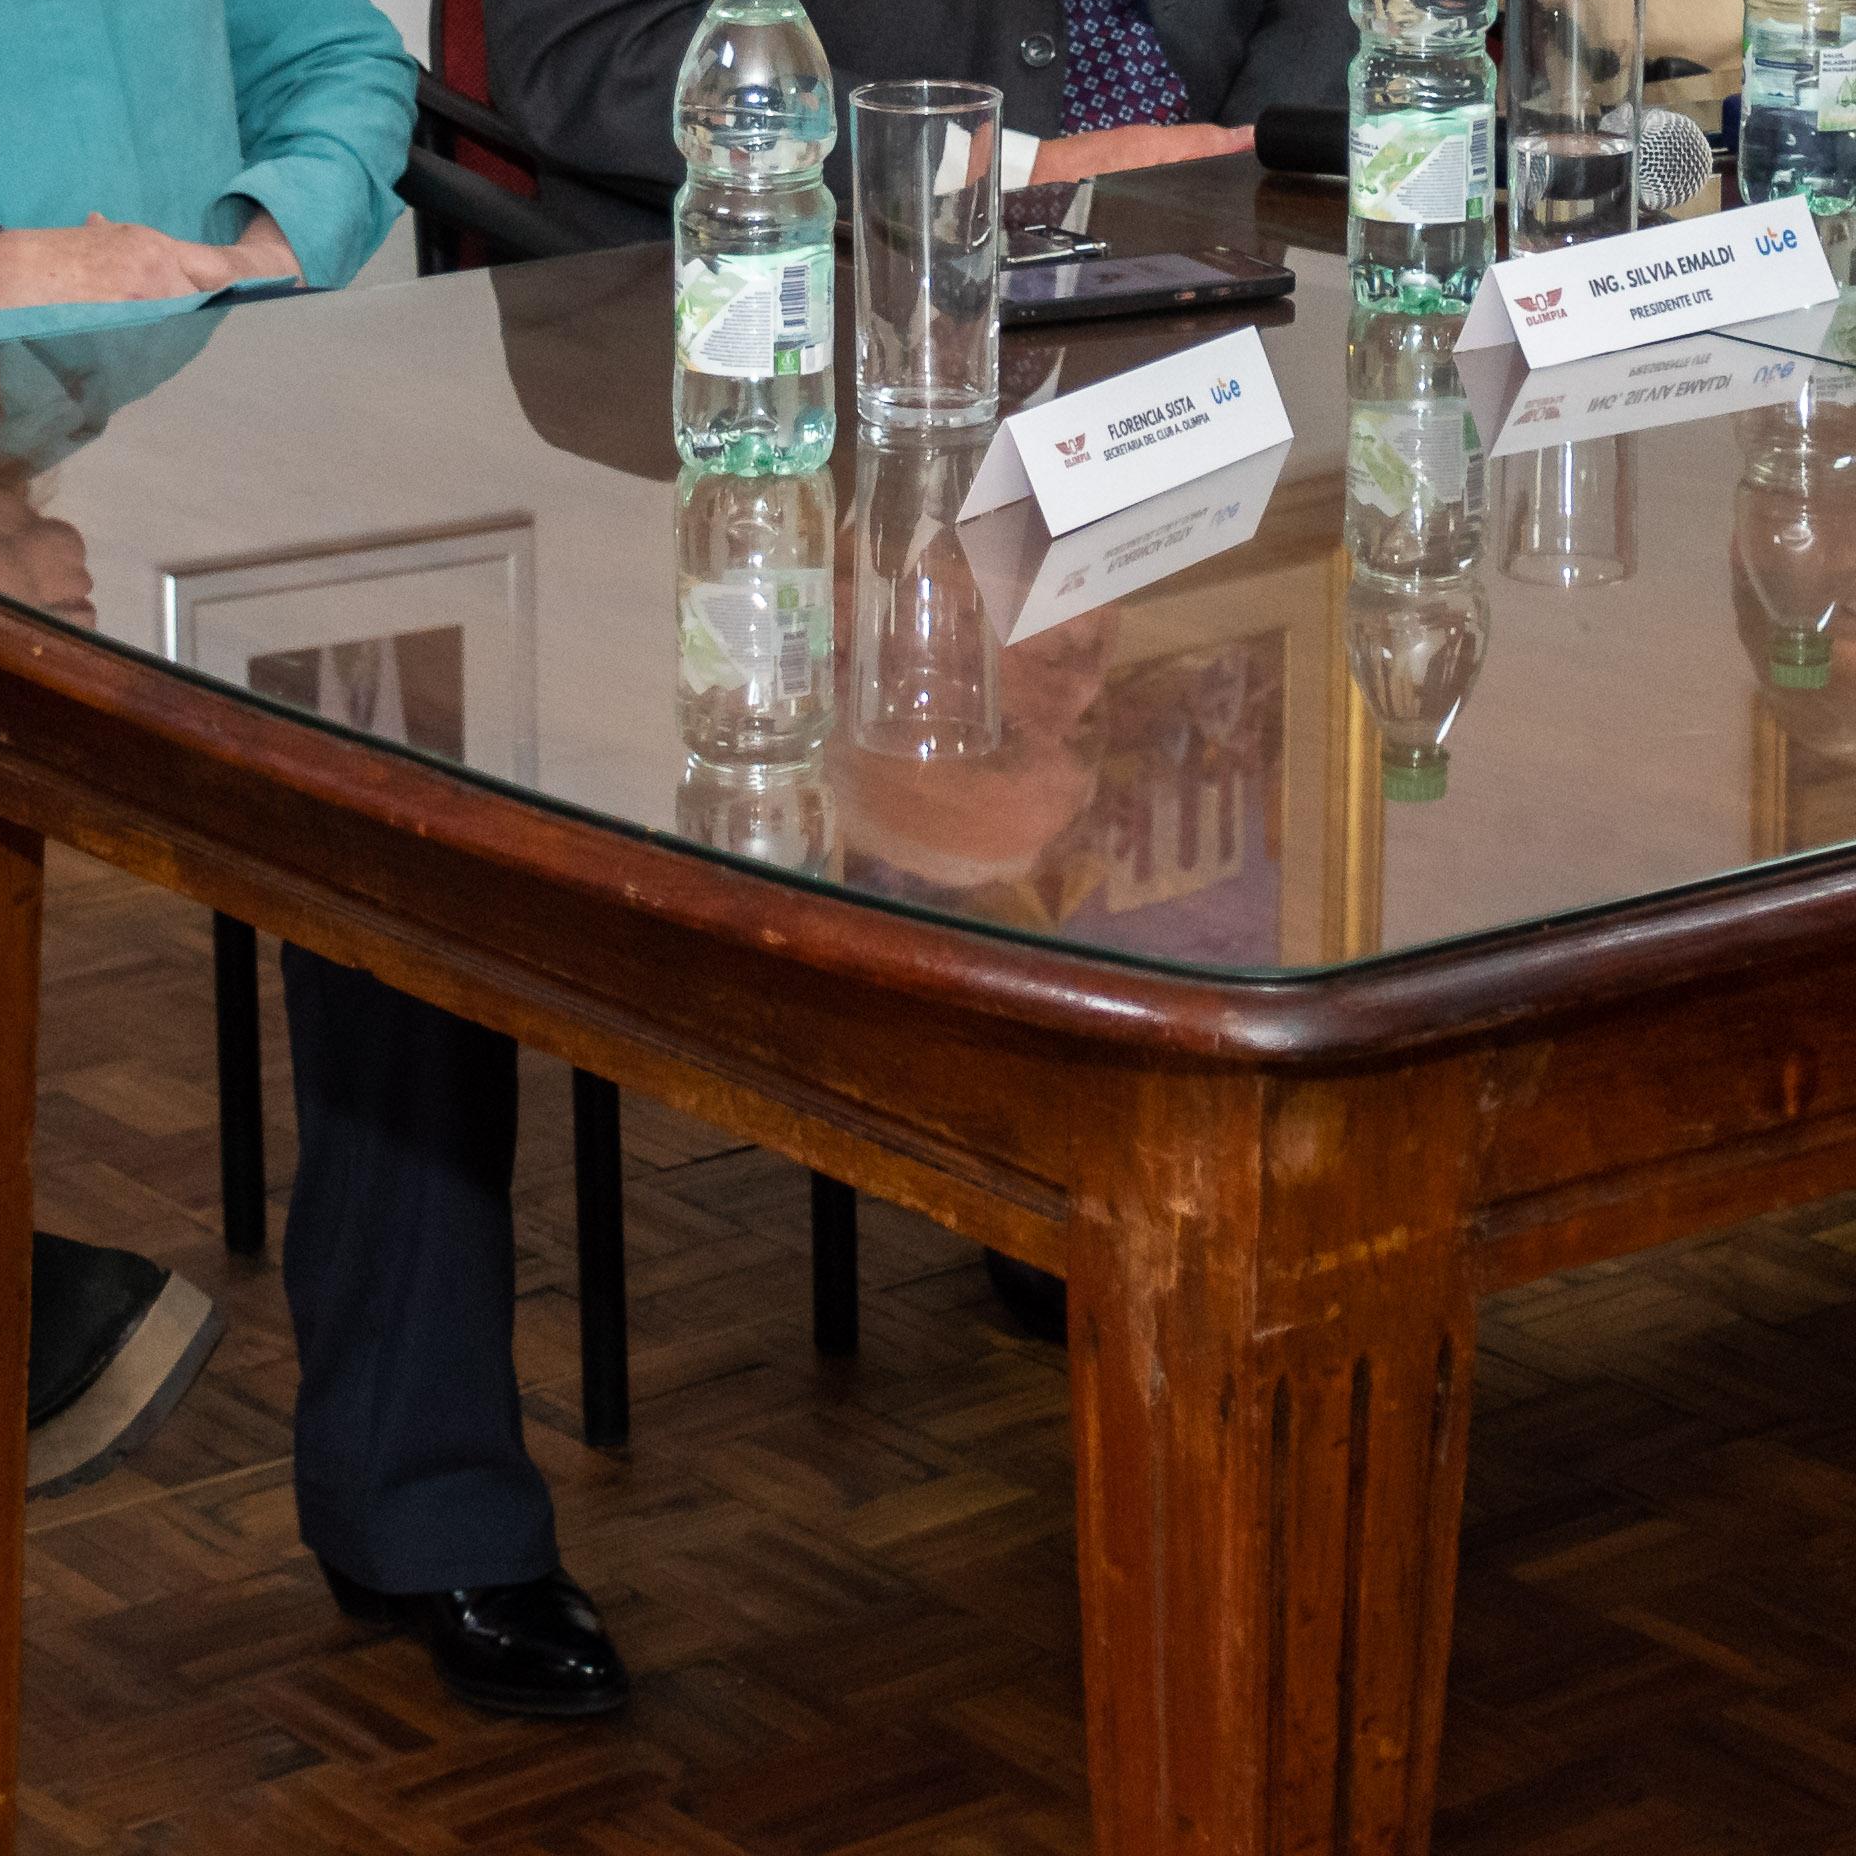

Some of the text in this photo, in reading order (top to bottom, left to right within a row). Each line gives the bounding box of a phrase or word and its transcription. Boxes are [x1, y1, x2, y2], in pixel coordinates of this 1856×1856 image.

[1755, 226, 1798, 257] ute
[1588, 245, 1736, 298] ING. SILVIA EMALDI
[1525, 307, 1568, 327] OLIMPIA
[1630, 288, 1713, 321] PRESIDENTE UTE
[1210, 376, 1242, 404] ute
[1107, 395, 1196, 440] FLORENCIA SISTA
[1103, 438, 1144, 461] SECRETARIA
[1143, 433, 1157, 446] DEL
[1156, 426, 1175, 441] CLUB
[1182, 412, 1211, 430] OLIMPIA
